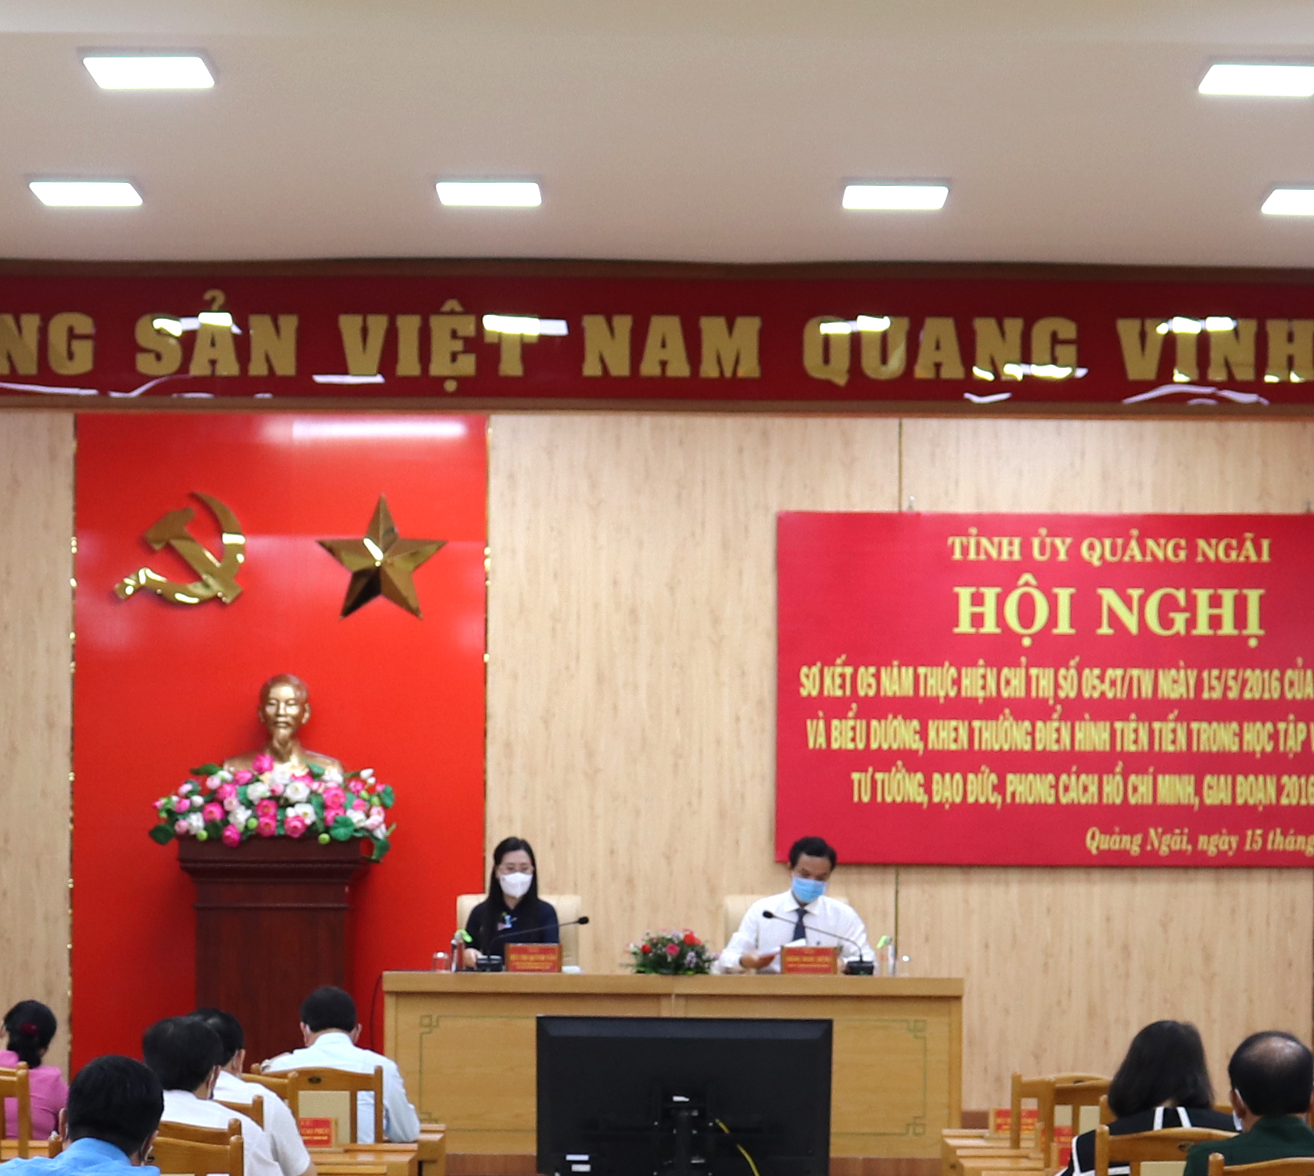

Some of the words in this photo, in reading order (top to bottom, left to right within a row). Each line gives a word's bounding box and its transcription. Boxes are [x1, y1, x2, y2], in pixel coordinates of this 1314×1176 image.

[134, 290, 298, 377] SẢN
[338, 300, 540, 392] VIỆT
[582, 315, 762, 379] NAM
[802, 316, 1078, 386] QUANG
[948, 527, 1023, 561] TỈNH
[1031, 527, 1072, 561] ỦY
[1080, 528, 1186, 567] QUẢNG
[1196, 532, 1271, 562] NGÃI
[953, 572, 1077, 648] HỘI
[1096, 587, 1266, 648] NGHỊ
[800, 662, 820, 697] SƠ
[823, 655, 854, 697] KẾT
[857, 666, 877, 697] 05
[880, 661, 914, 697] NĂM
[961, 659, 997, 703] HIỆN
[1000, 656, 1026, 698] CHỈ
[1029, 667, 1055, 705] THỊ
[1057, 656, 1078, 699] SỐ
[1081, 668, 1155, 699] 05-CT/TW
[1158, 661, 1197, 699] NGÀY
[1202, 669, 1281, 699] 15/5/2016
[1284, 657, 1314, 699] CỦA
[807, 711, 826, 749] VÀ
[831, 703, 866, 750] BIỂU
[870, 714, 924, 755] DƯƠNG,
[928, 720, 969, 750] KHEN
[1075, 713, 1110, 751] HÌNH
[1190, 722, 1239, 752] TRONG
[1243, 722, 1274, 757] HỌC
[1277, 715, 1307, 758] TẬP
[851, 767, 871, 803] TƯ
[932, 773, 964, 809] ĐẠO
[1006, 773, 1056, 804] PHONG
[1058, 766, 1098, 804] CÁCH
[1103, 761, 1124, 804] HỒ
[1128, 767, 1153, 804] CHÍ
[1157, 774, 1201, 811] MINH,
[1203, 775, 1232, 805] GIAI
[1236, 775, 1276, 810] ĐOẠN
[1086, 827, 1142, 855] Quảng
[1198, 828, 1238, 855] ngày
[1246, 829, 1262, 850] 15
